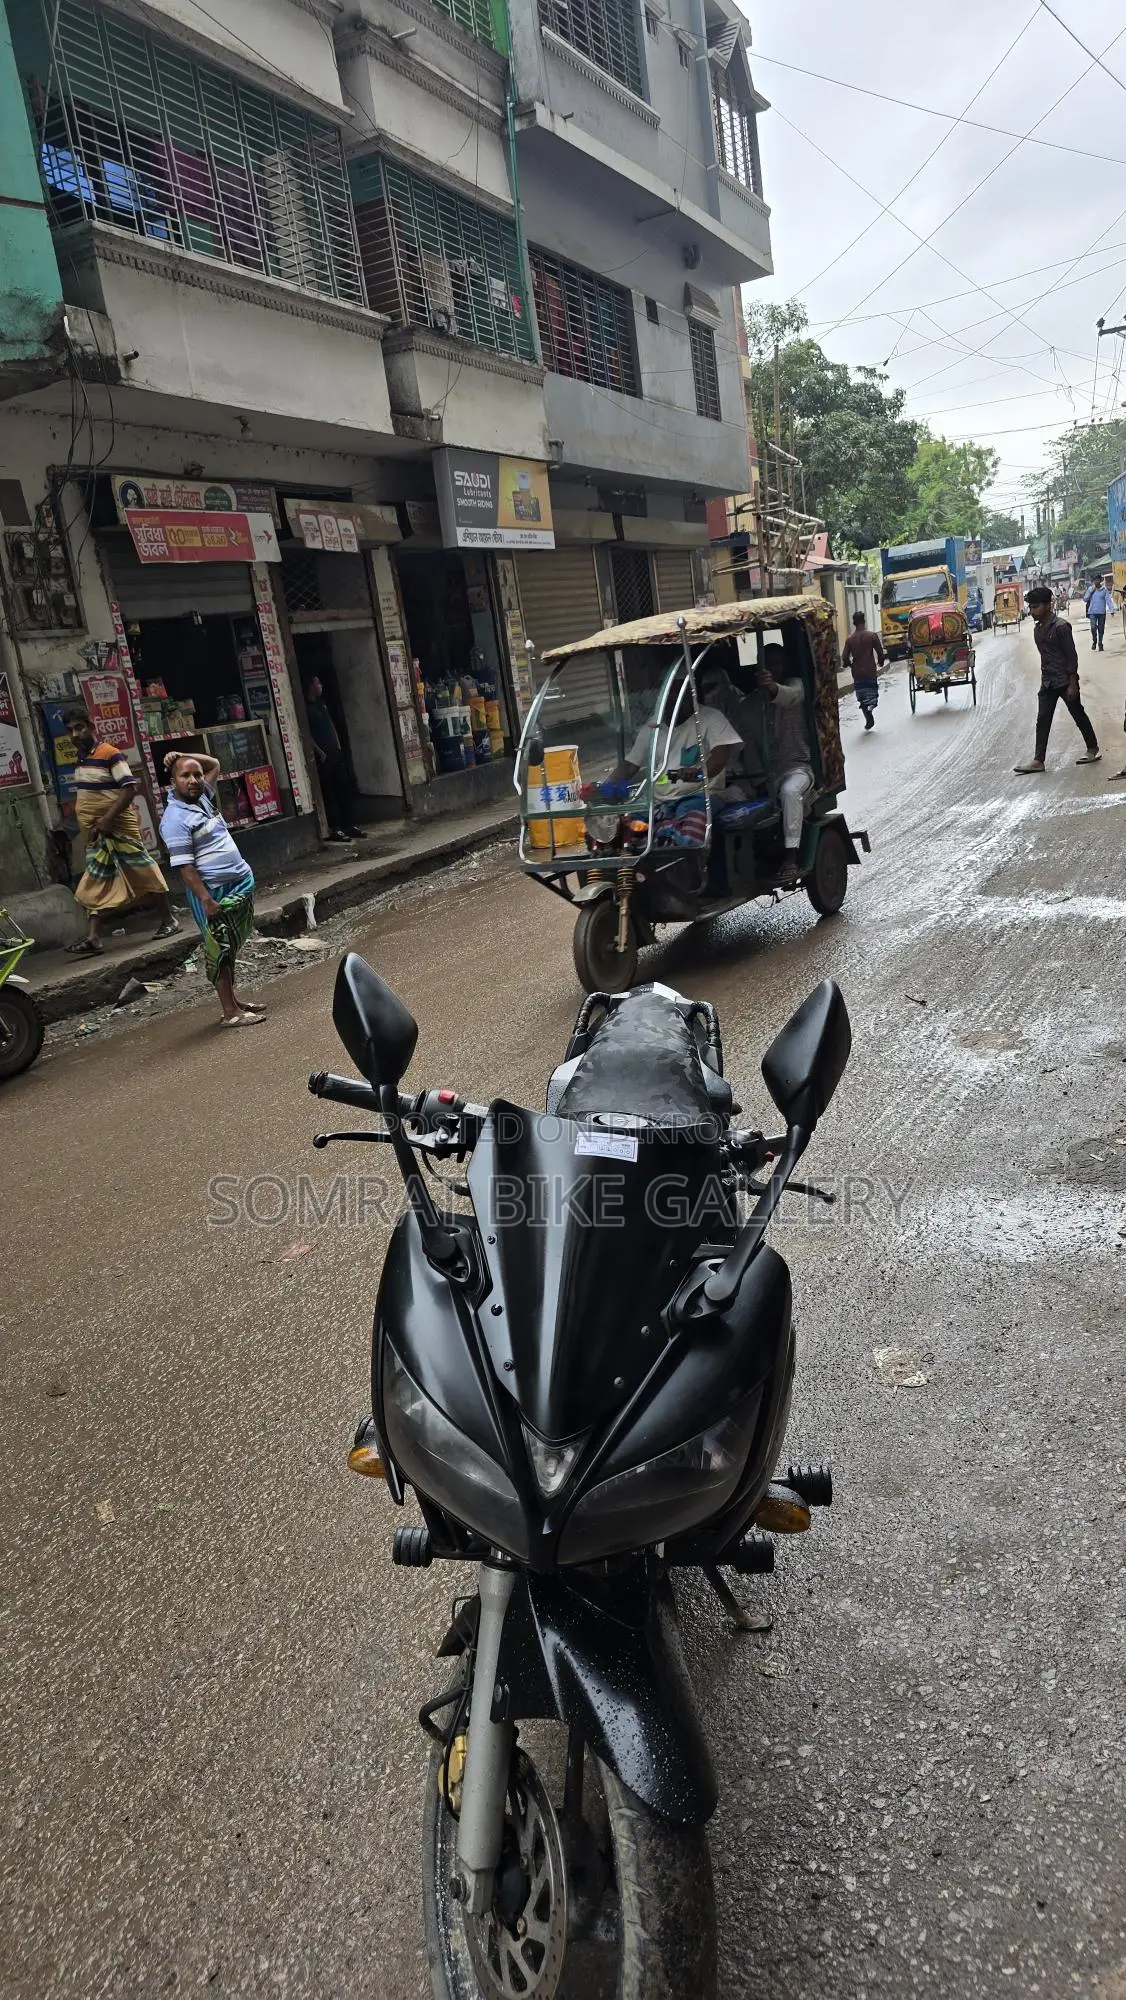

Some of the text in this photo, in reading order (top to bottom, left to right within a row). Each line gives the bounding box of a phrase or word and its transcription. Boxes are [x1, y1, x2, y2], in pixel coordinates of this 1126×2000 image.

[454, 471, 491, 489] SAUDI
[134, 523, 165, 543] সুবিধা
[138, 542, 169, 557] ডাবল
[94, 716, 128, 734] বিকাশ
